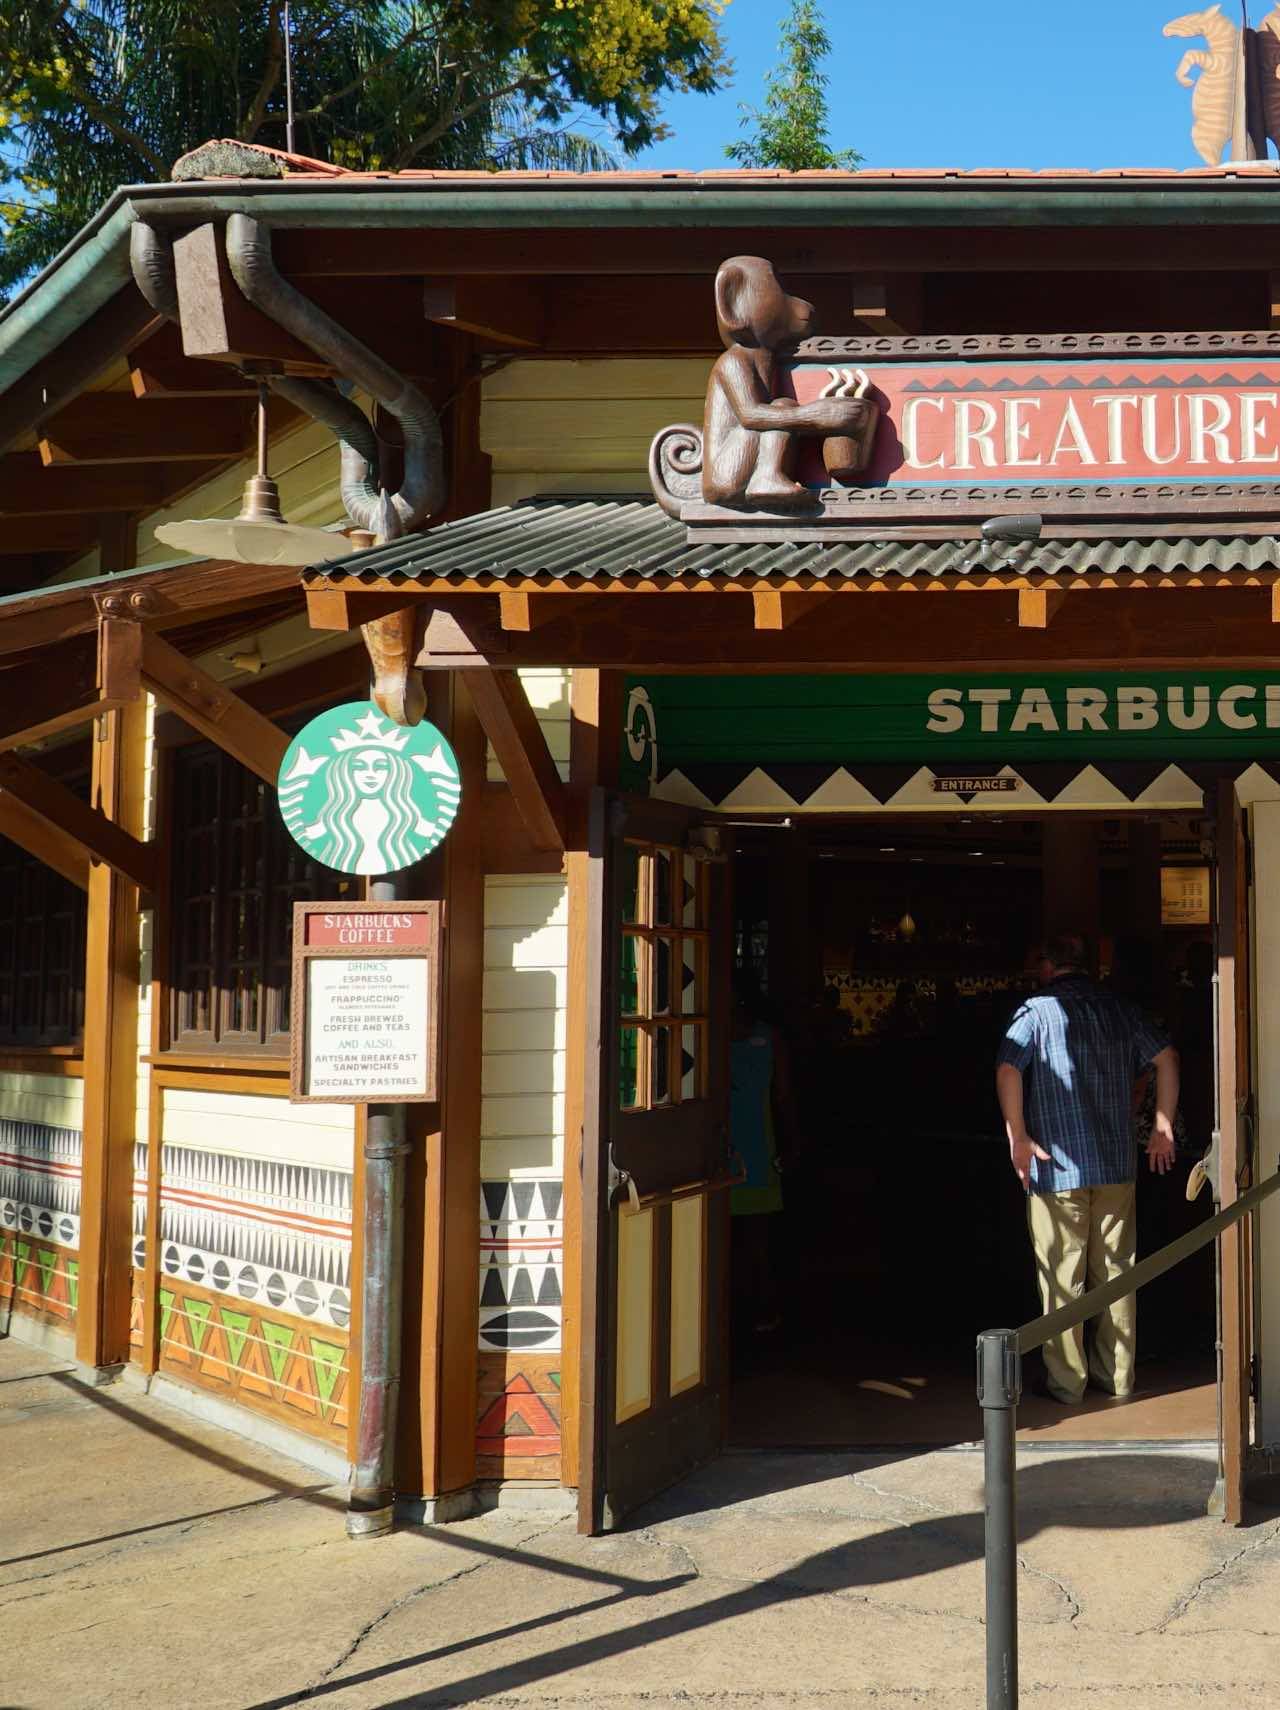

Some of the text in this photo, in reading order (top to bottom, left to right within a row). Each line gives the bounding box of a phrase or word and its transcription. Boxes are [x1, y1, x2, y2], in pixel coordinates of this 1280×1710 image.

[902, 393, 1280, 470] CREATURE
[941, 779, 1008, 791] ENTRANCE
[324, 914, 412, 928] STARBUCKS
[339, 928, 394, 943] COFFEE
[343, 974, 393, 983] ESPRESSO
[330, 1014, 404, 1023] FRESH BREWED
[323, 1024, 360, 1032] COFFEE
[387, 1023, 410, 1031] TEAS
[338, 1039, 359, 1048] AND
[315, 1053, 417, 1063] ARTISAN BREAKFAST
[334, 1062, 399, 1072] SANDWICHES
[314, 1077, 417, 1087] SPECIALTY PASTRIES
